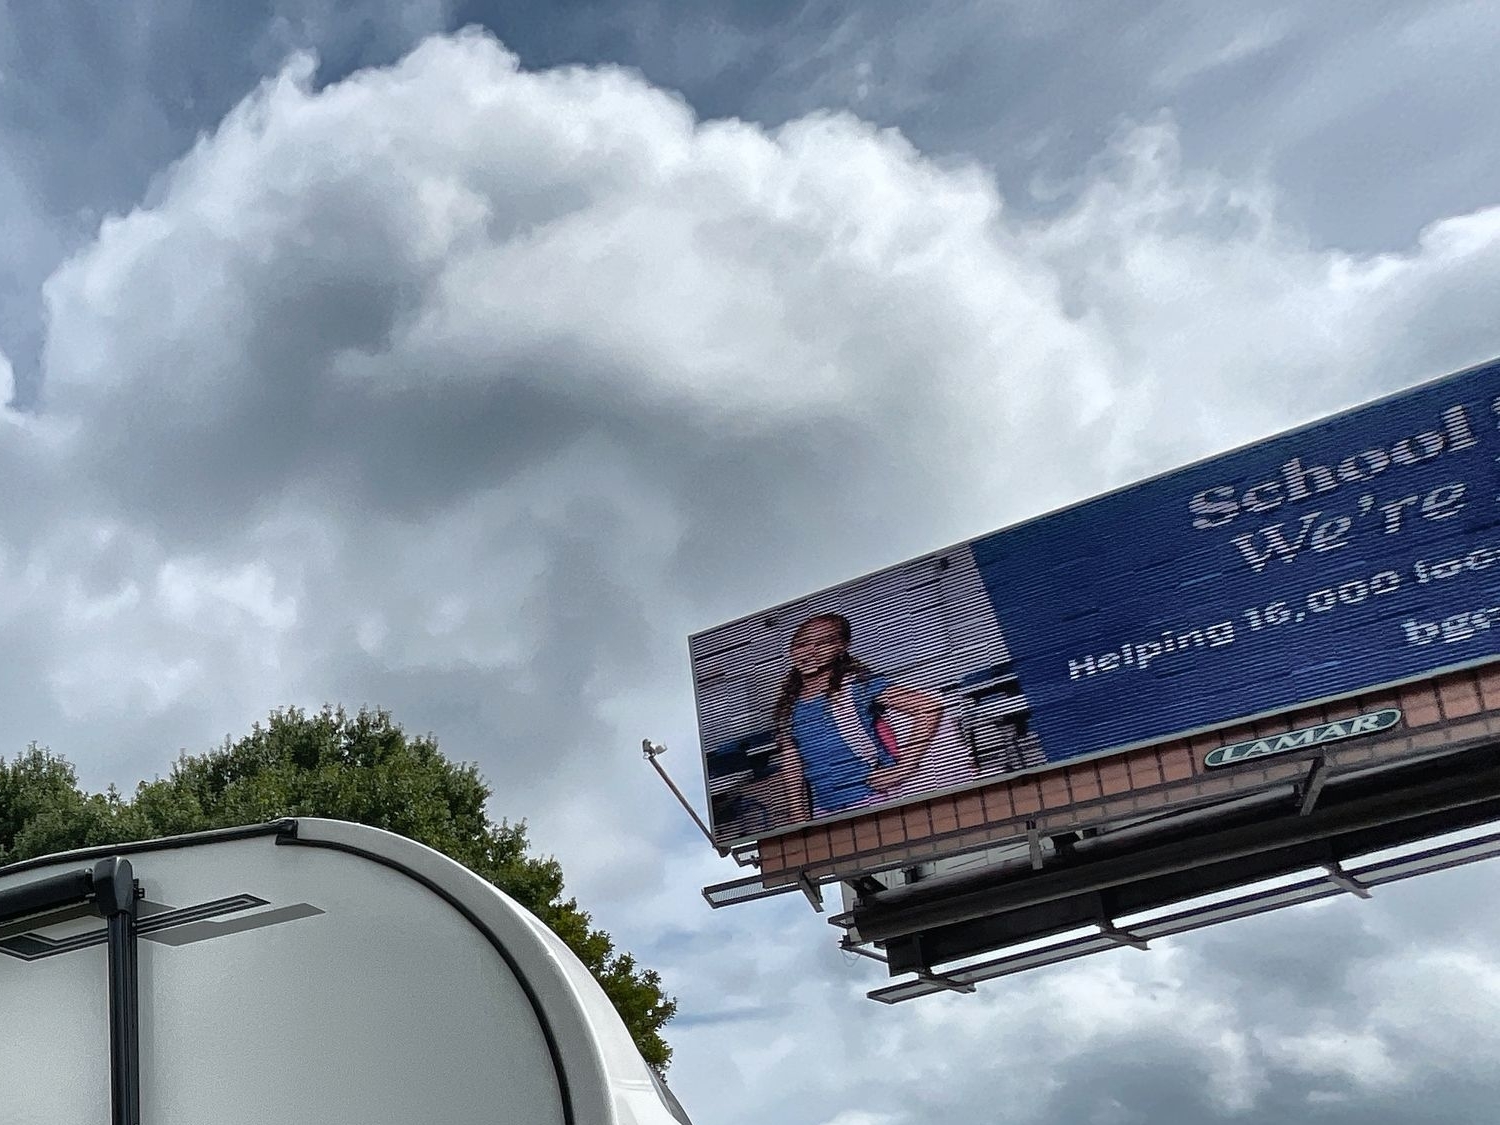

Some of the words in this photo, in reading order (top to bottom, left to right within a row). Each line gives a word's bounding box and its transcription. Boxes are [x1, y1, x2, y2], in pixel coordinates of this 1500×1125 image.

[1189, 404, 1478, 530] School
[1229, 483, 1467, 573] We're
[1068, 621, 1235, 680] Helping
[1414, 548, 1500, 583] loc
[1220, 713, 1382, 761] LAMAR
